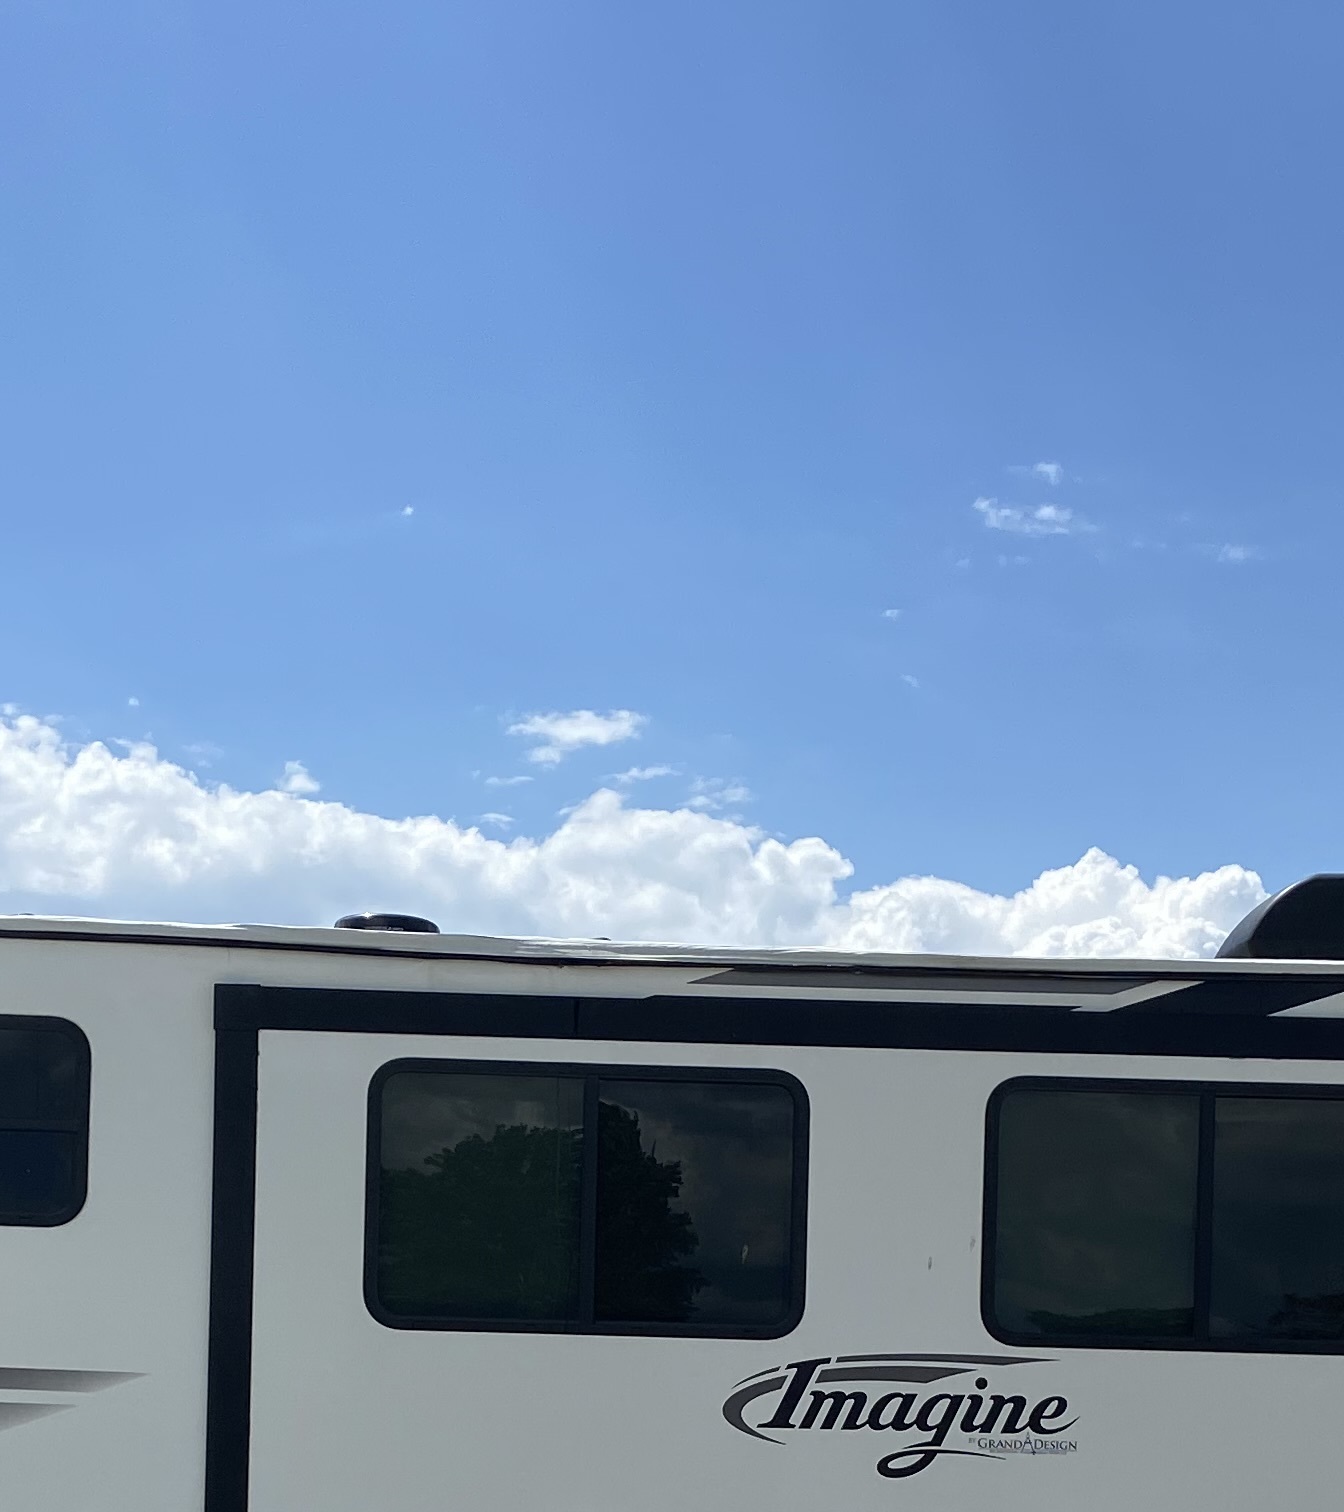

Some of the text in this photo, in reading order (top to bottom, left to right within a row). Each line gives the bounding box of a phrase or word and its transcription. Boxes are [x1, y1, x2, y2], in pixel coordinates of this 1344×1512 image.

[756, 1357, 1080, 1478] Imagine
[977, 1437, 1023, 1449] GRAND
[1034, 1439, 1077, 1452] DESIGN
